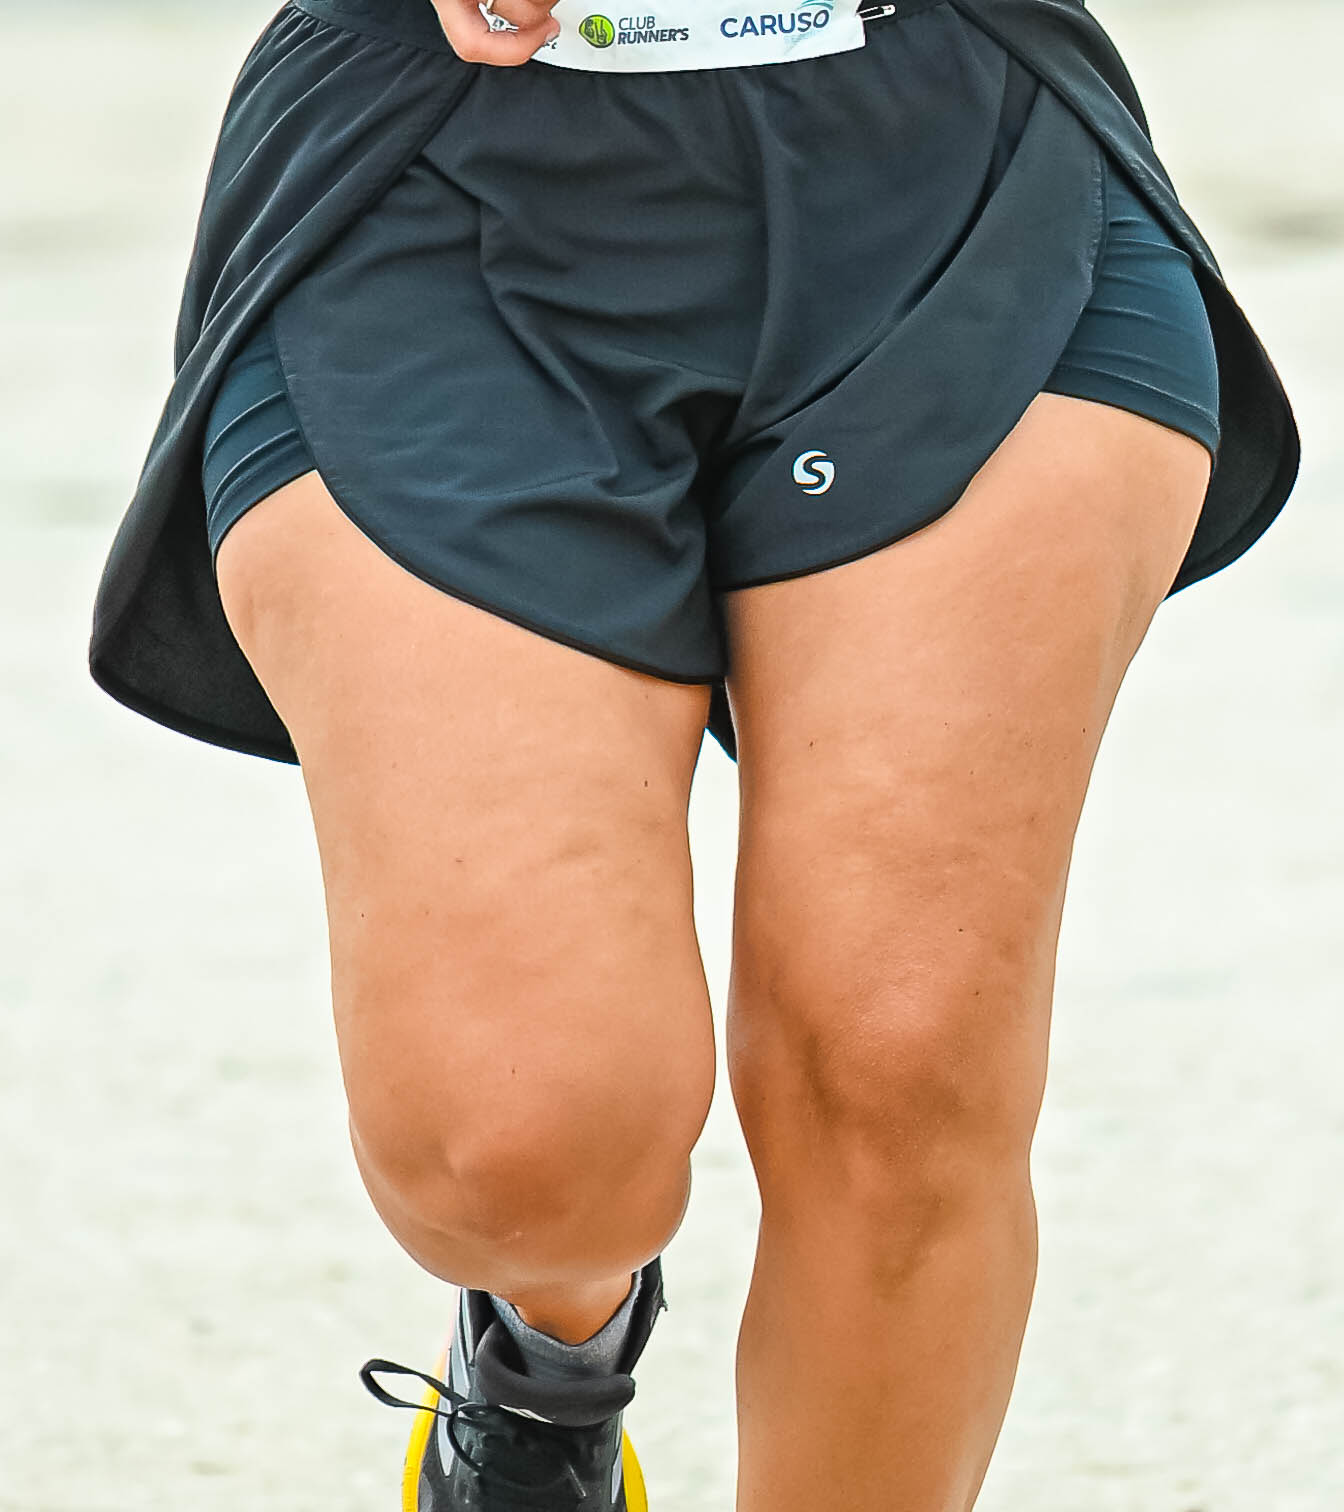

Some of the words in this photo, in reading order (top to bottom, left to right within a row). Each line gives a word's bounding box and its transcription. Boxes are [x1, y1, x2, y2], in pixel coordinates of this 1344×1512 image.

[618, 15, 656, 30] CLUB
[720, 9, 830, 39] CARUSO
[617, 27, 690, 44] RUNNER'S
